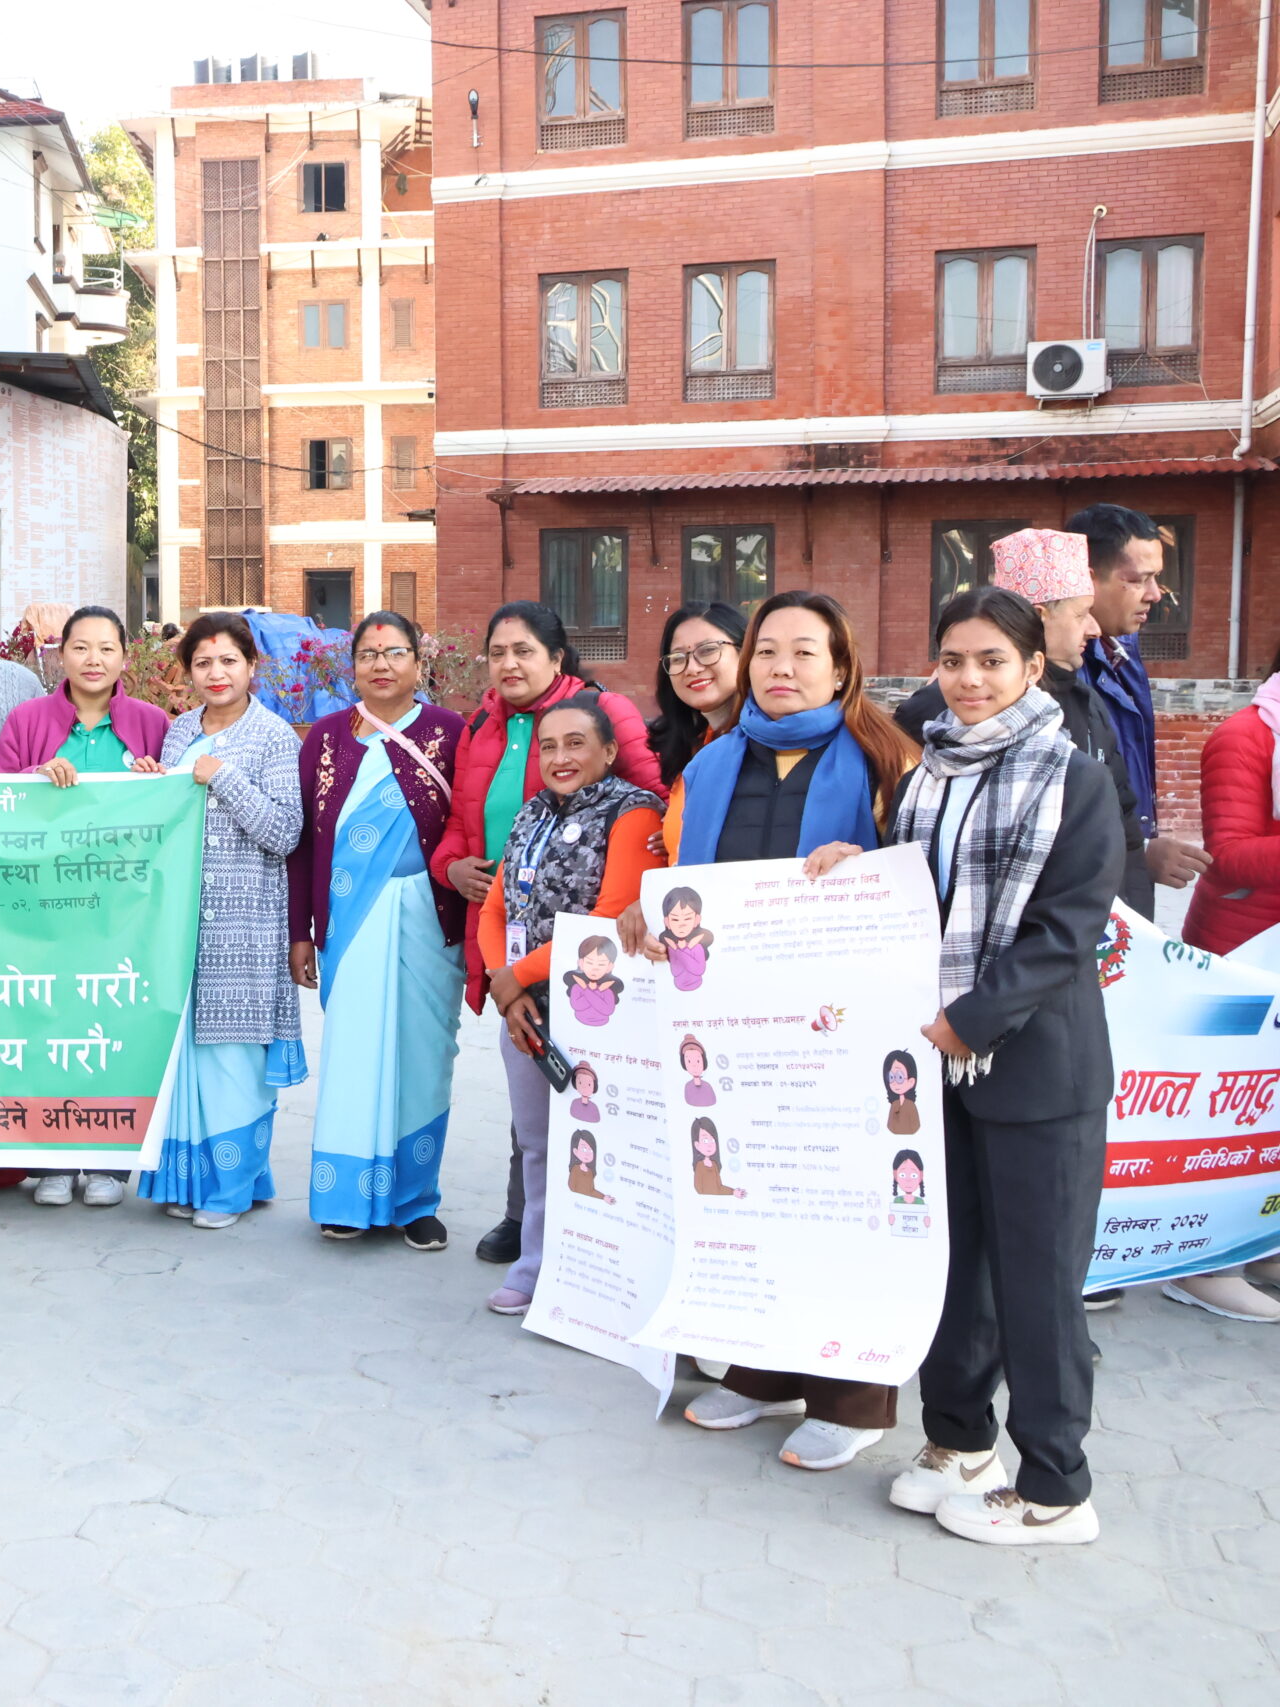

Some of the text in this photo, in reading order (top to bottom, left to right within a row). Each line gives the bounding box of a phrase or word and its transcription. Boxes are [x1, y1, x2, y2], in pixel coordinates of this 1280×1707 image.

[60, 822, 165, 848] पर्यावरण
[54, 853, 150, 884] लिमिटेड
[1114, 1069, 1201, 1120] शान्त,
[42, 1099, 136, 1131] अभियान
[1170, 1212, 1208, 1231] २०२५
[1122, 1246, 1144, 1261] २४
[1151, 1240, 1173, 1256] गते
[858, 1347, 890, 1364] cbm
